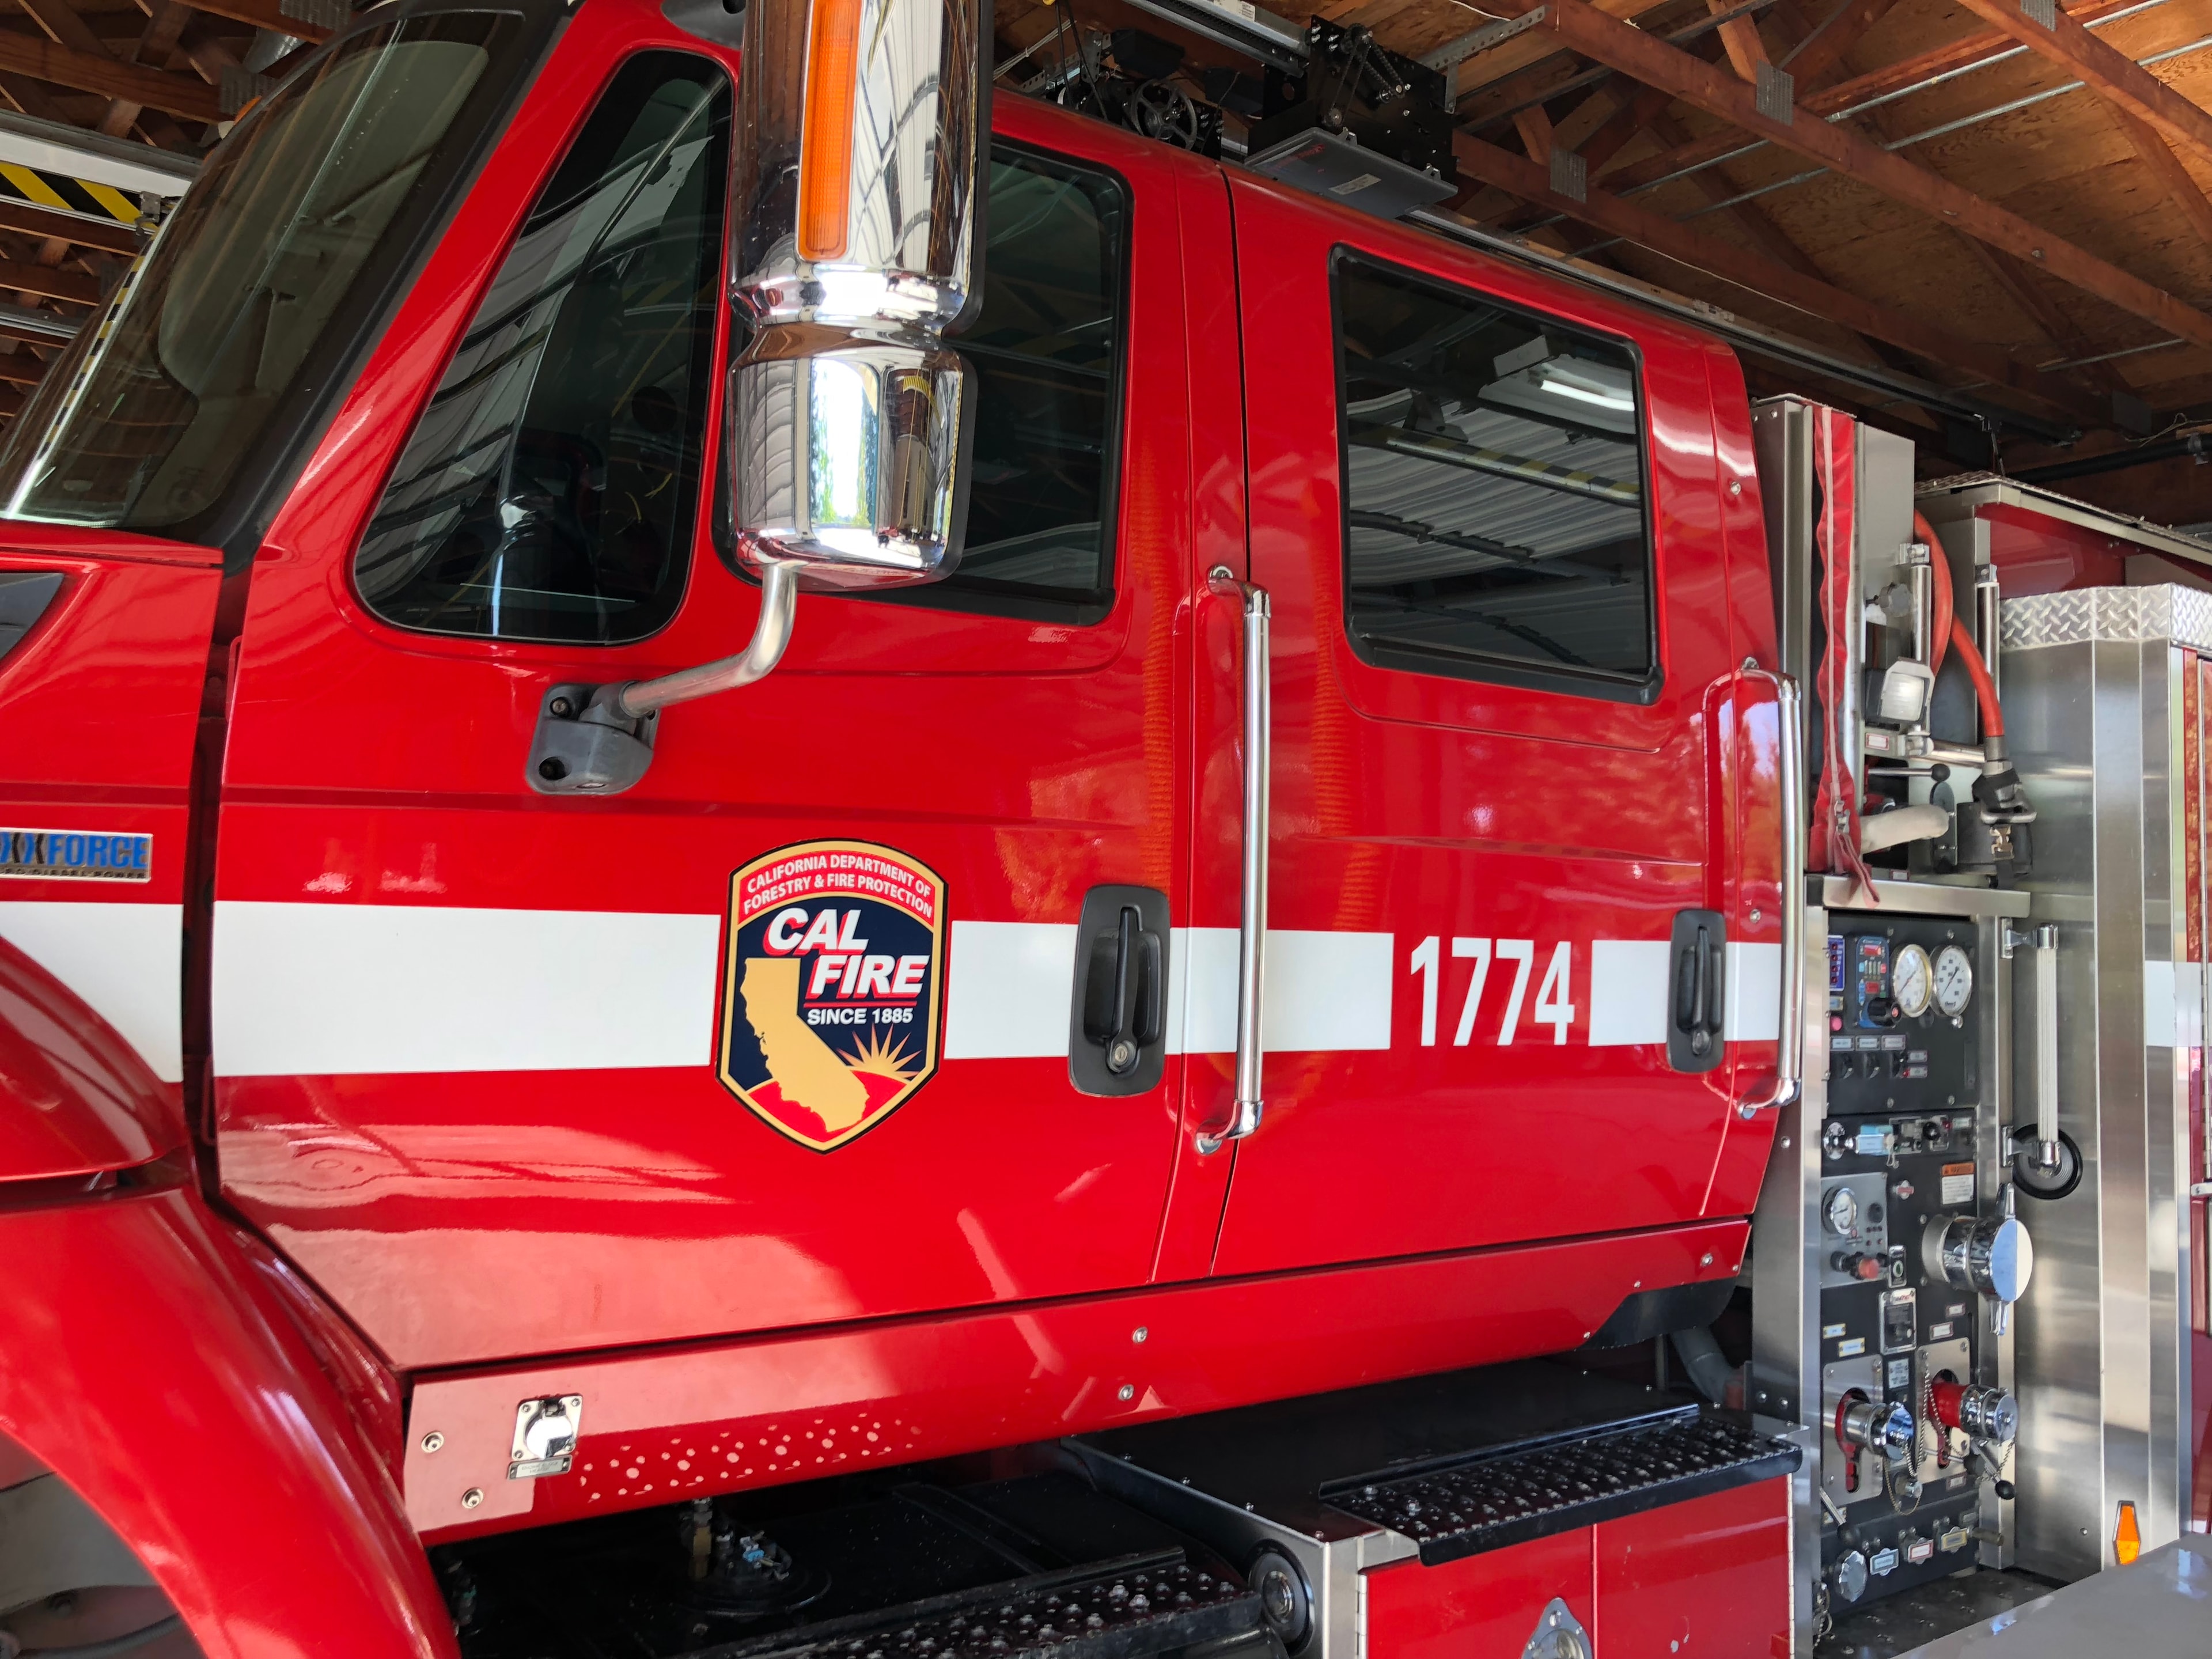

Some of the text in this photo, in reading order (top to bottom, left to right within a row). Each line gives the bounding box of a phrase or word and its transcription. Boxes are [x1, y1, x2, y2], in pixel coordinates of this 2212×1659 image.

[743, 873, 933, 918] FORESTRY & FIRE PROTECTION
[747, 854, 931, 897] CALIFORNIA DEPARTMENT OF
[763, 907, 869, 956] CAL
[805, 955, 930, 999] FIRE
[1411, 935, 1575, 1046] 1774
[807, 1007, 914, 1025] SINCE 1885
